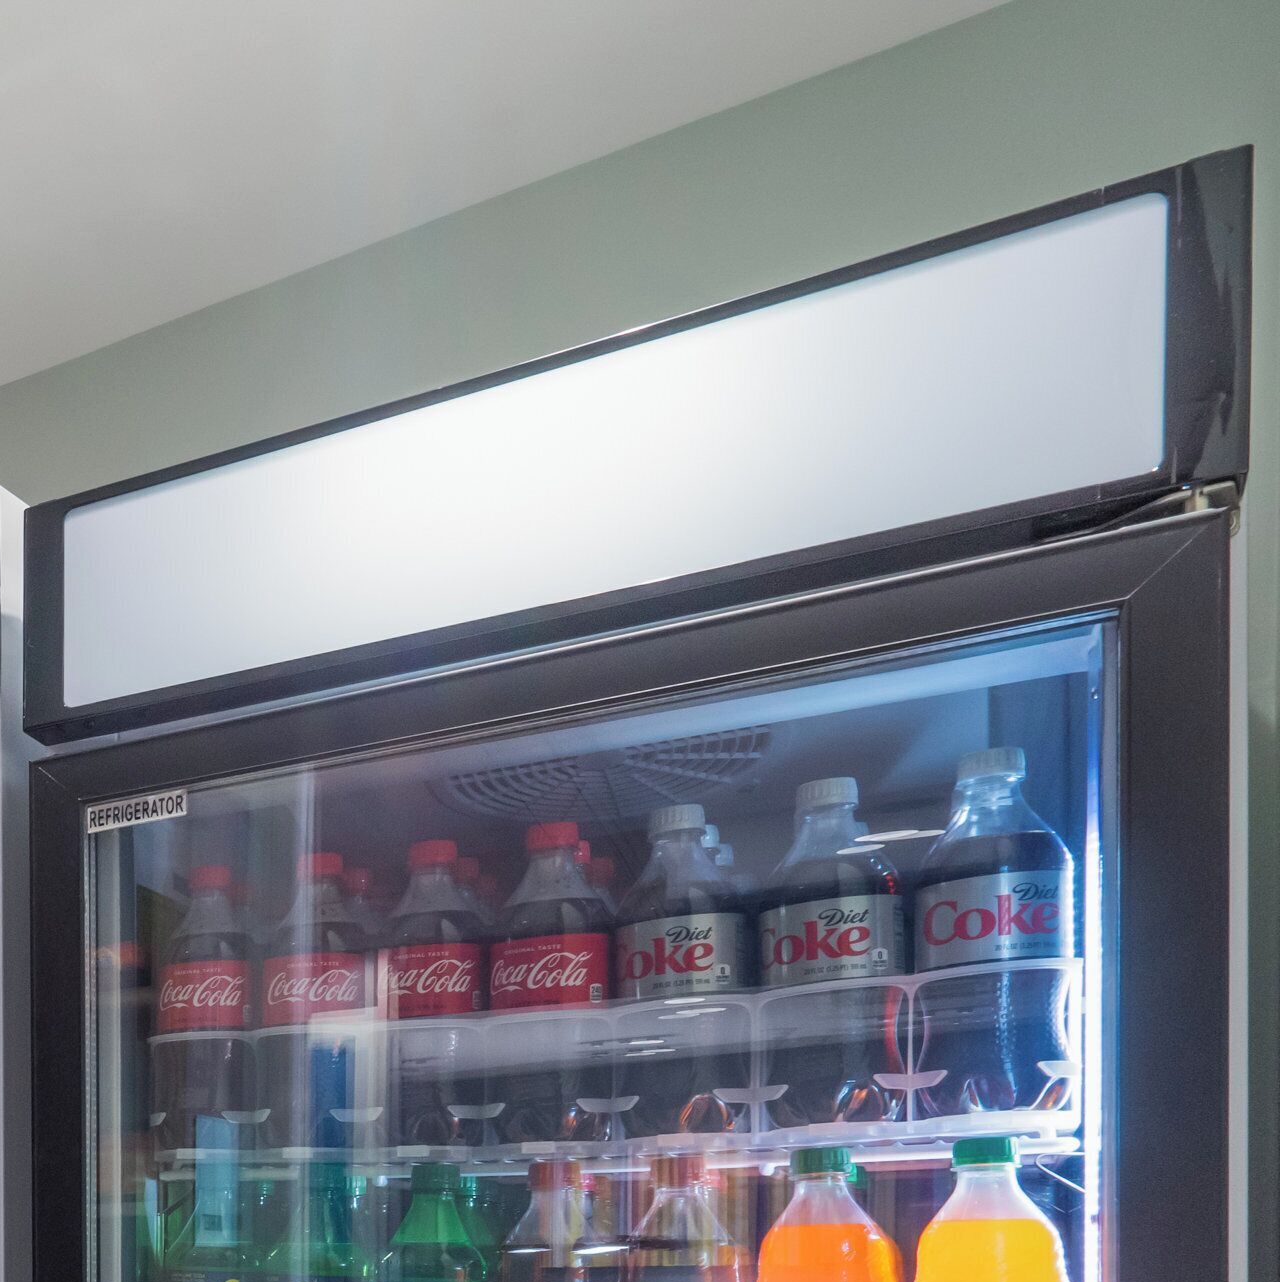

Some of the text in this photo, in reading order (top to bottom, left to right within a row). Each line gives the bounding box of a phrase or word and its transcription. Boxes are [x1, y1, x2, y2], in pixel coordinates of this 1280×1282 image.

[90, 795, 184, 828] REFRIGERATOR
[1013, 882, 1057, 900] Diet
[819, 908, 869, 926] Diet
[923, 894, 1059, 945] Coke
[666, 926, 712, 943] Diet
[268, 970, 360, 1006] Coca-Cola
[491, 952, 592, 995] Coca-Cola
[160, 976, 245, 1010] Coca-Cola
